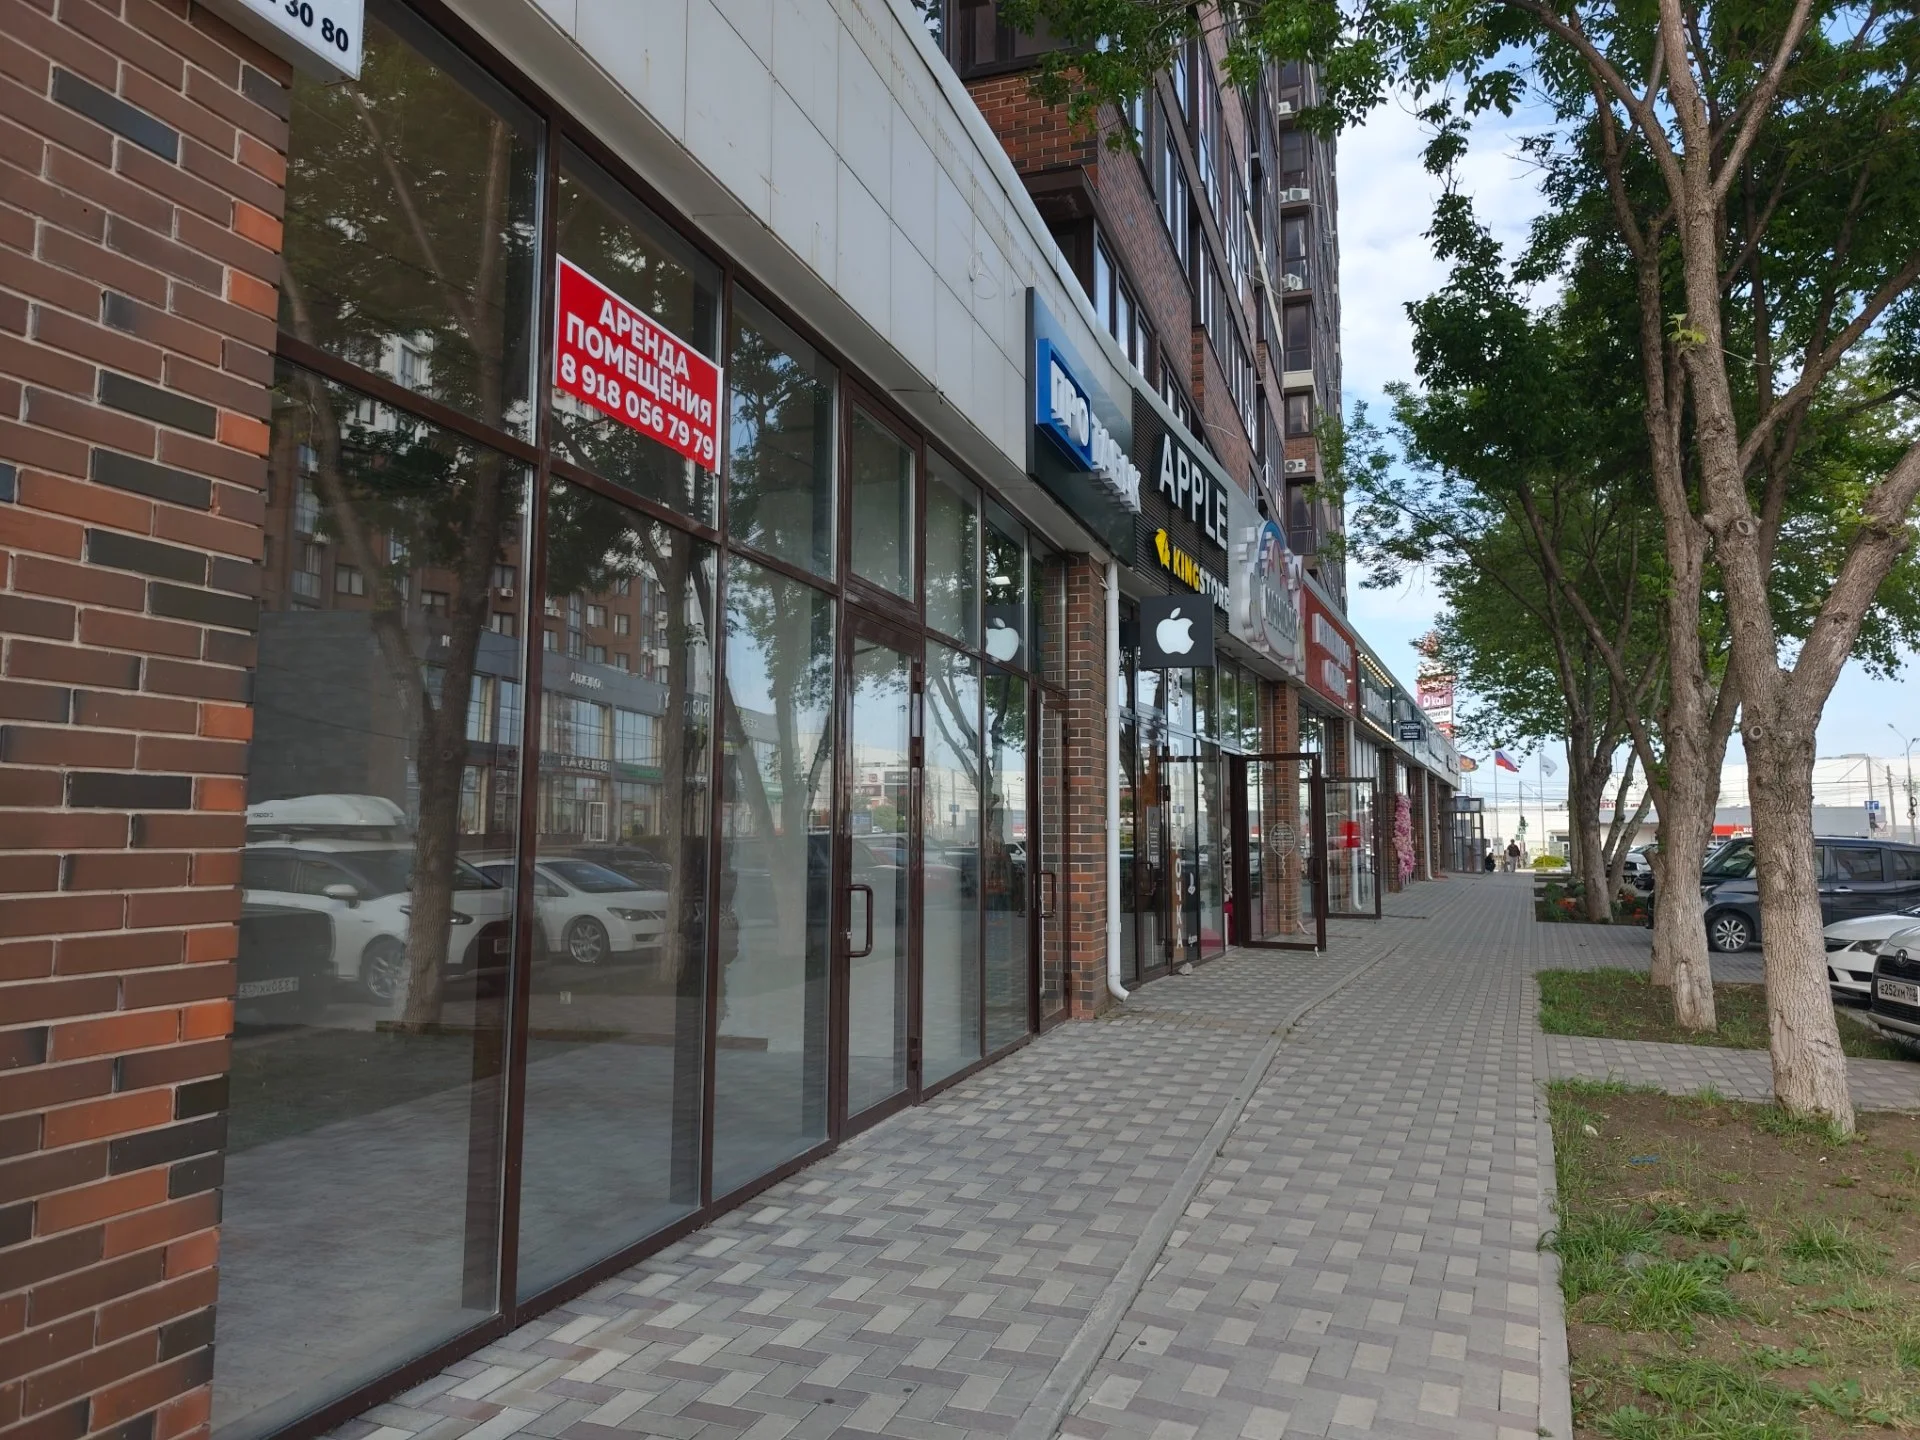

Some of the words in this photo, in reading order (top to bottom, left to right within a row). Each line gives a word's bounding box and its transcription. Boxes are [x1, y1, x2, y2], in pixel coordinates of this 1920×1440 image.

[284, 0, 314, 27] 30
[321, 17, 349, 52] 80
[566, 312, 711, 427] ПОМЕЩЕНИЯ
[599, 299, 690, 381] АРЕНДА
[561, 353, 576, 384] 8
[581, 365, 621, 410] 918
[625, 390, 664, 433] 056
[667, 413, 690, 447] 79
[693, 428, 714, 461] 79
[1159, 433, 1227, 551] APPLE
